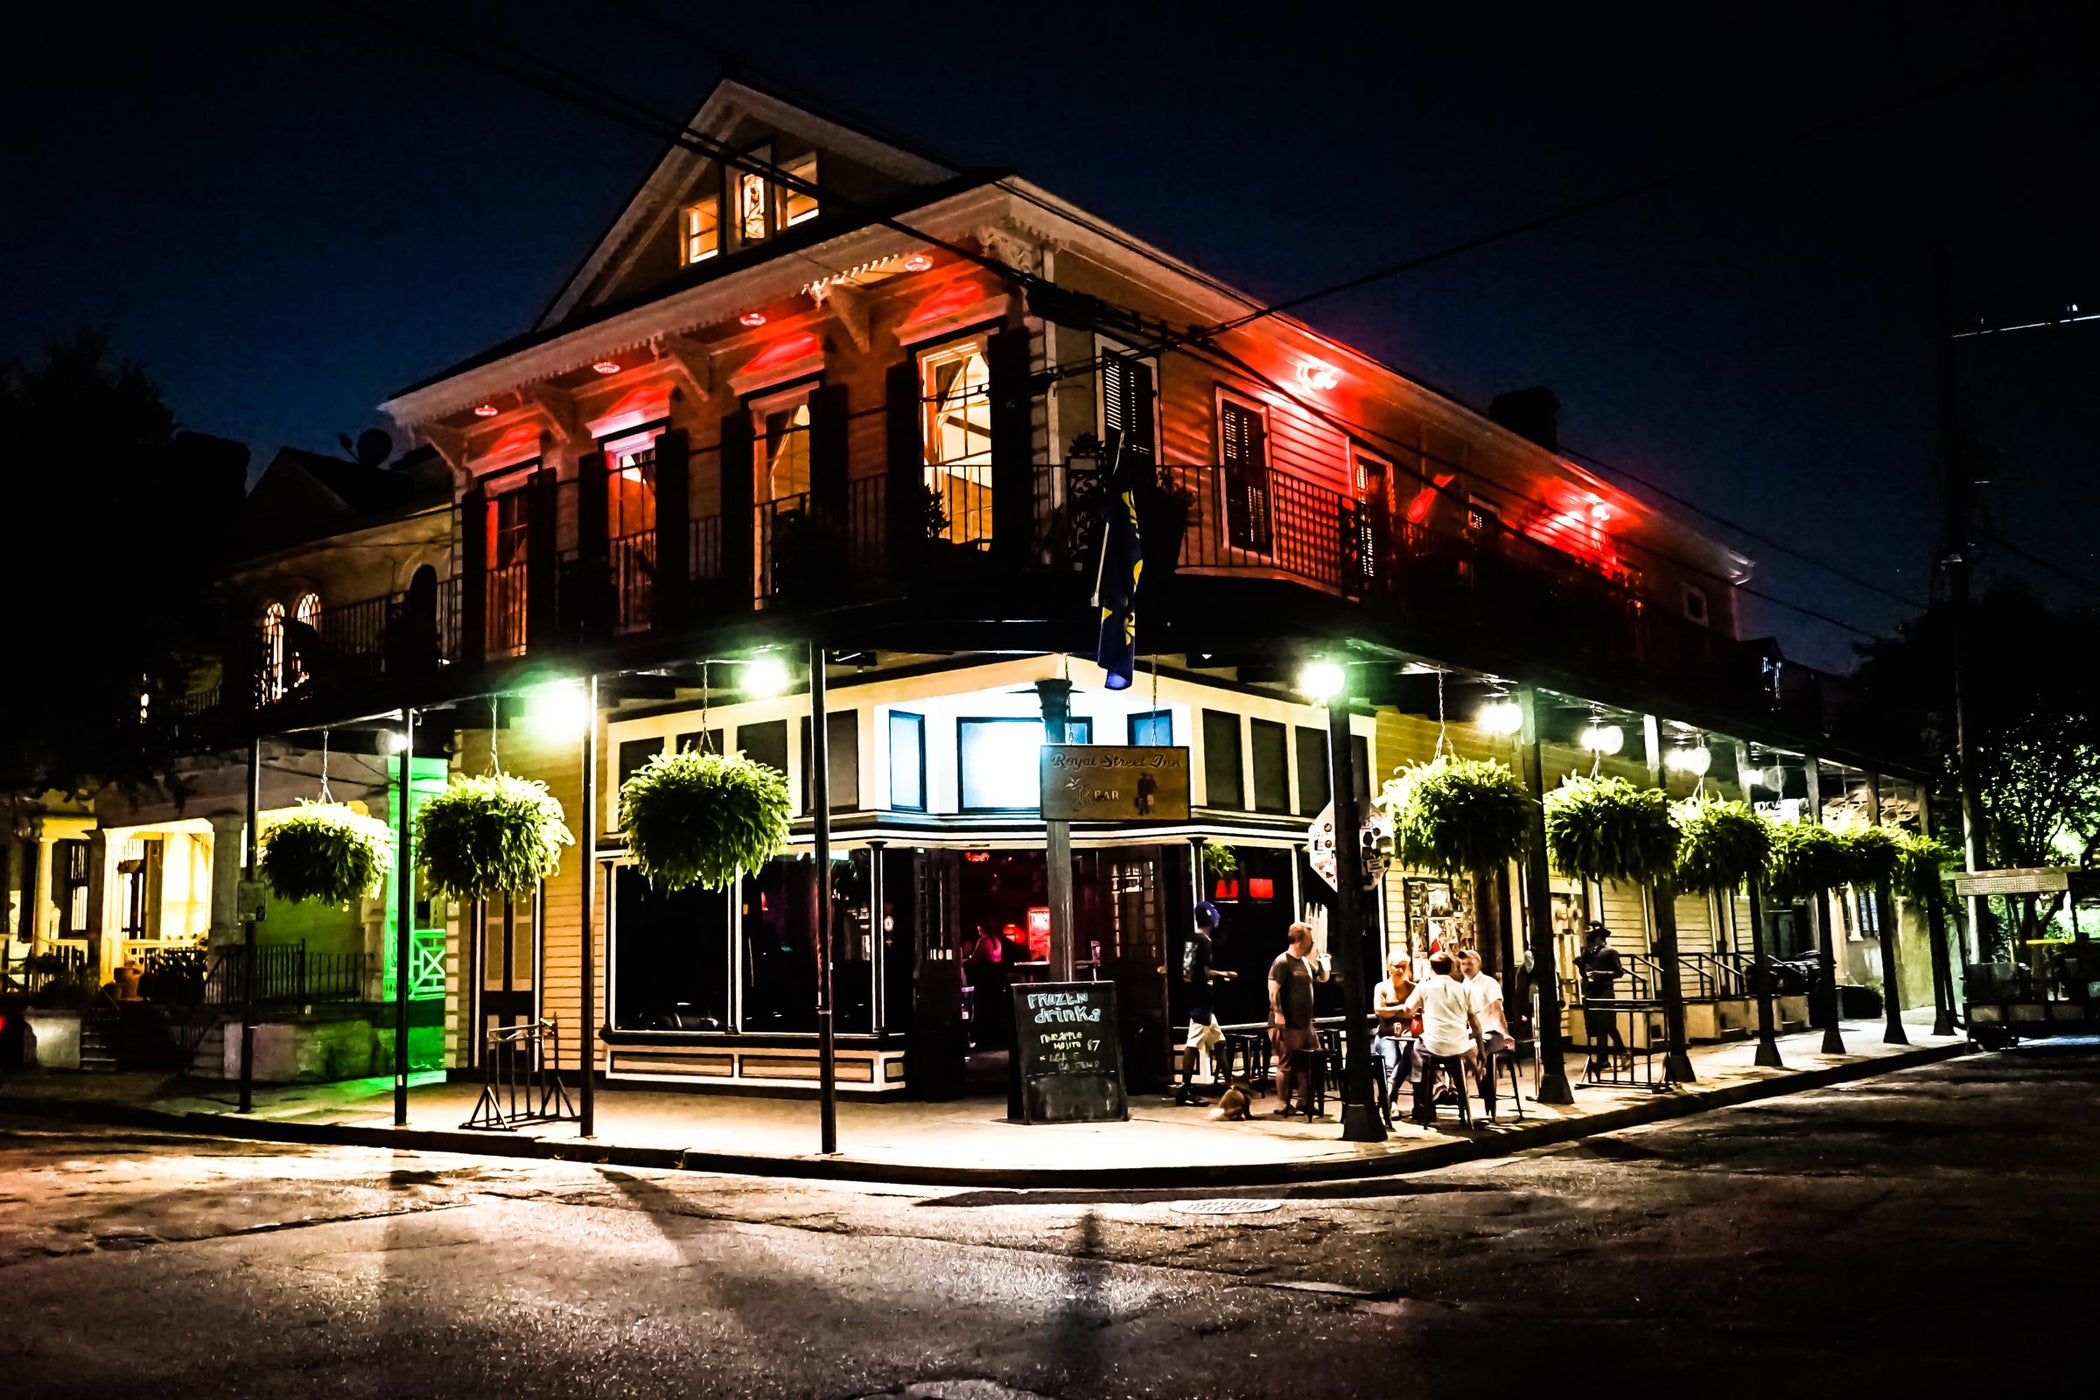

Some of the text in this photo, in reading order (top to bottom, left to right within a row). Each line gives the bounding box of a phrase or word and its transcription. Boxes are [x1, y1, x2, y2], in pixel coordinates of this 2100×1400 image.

[1052, 752, 1096, 772] Royal
[1101, 753, 1145, 769] Street
[1094, 790, 1120, 801] BAR
[1027, 993, 1087, 1009] FROZEN
